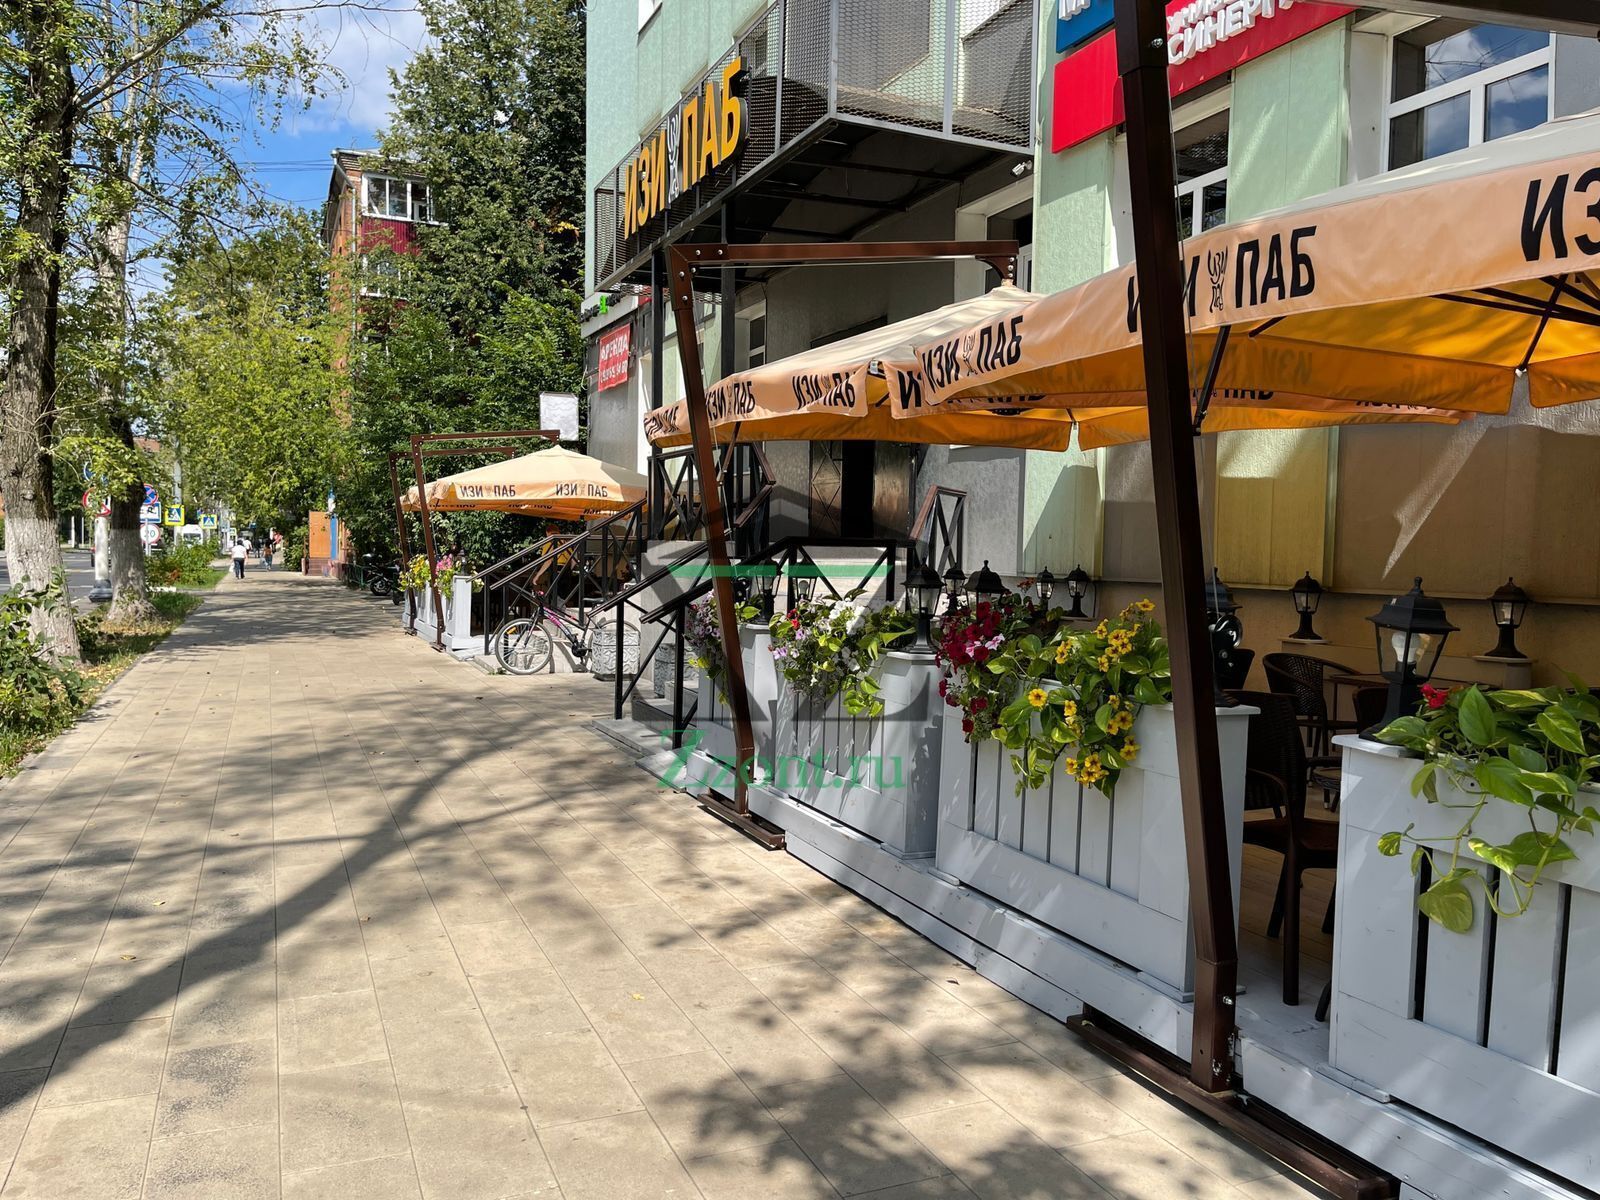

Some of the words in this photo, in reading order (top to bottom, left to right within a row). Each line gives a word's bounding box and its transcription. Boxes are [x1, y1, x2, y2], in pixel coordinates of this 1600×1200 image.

[624, 129, 667, 240] ИЗИ
[682, 56, 748, 193] ПАБ
[1235, 226, 1317, 309] ПАБ
[922, 337, 960, 394] ИЗИ
[976, 315, 1024, 374] ПАБ
[733, 380, 756, 415] ПАБ
[793, 374, 823, 410] ИЗИ
[823, 371, 856, 408] ПАБ
[460, 484, 484, 498] ИЗИ
[493, 484, 517, 498] ПАБ
[556, 483, 578, 497] ИЗИ
[587, 483, 609, 498] ПАБ
